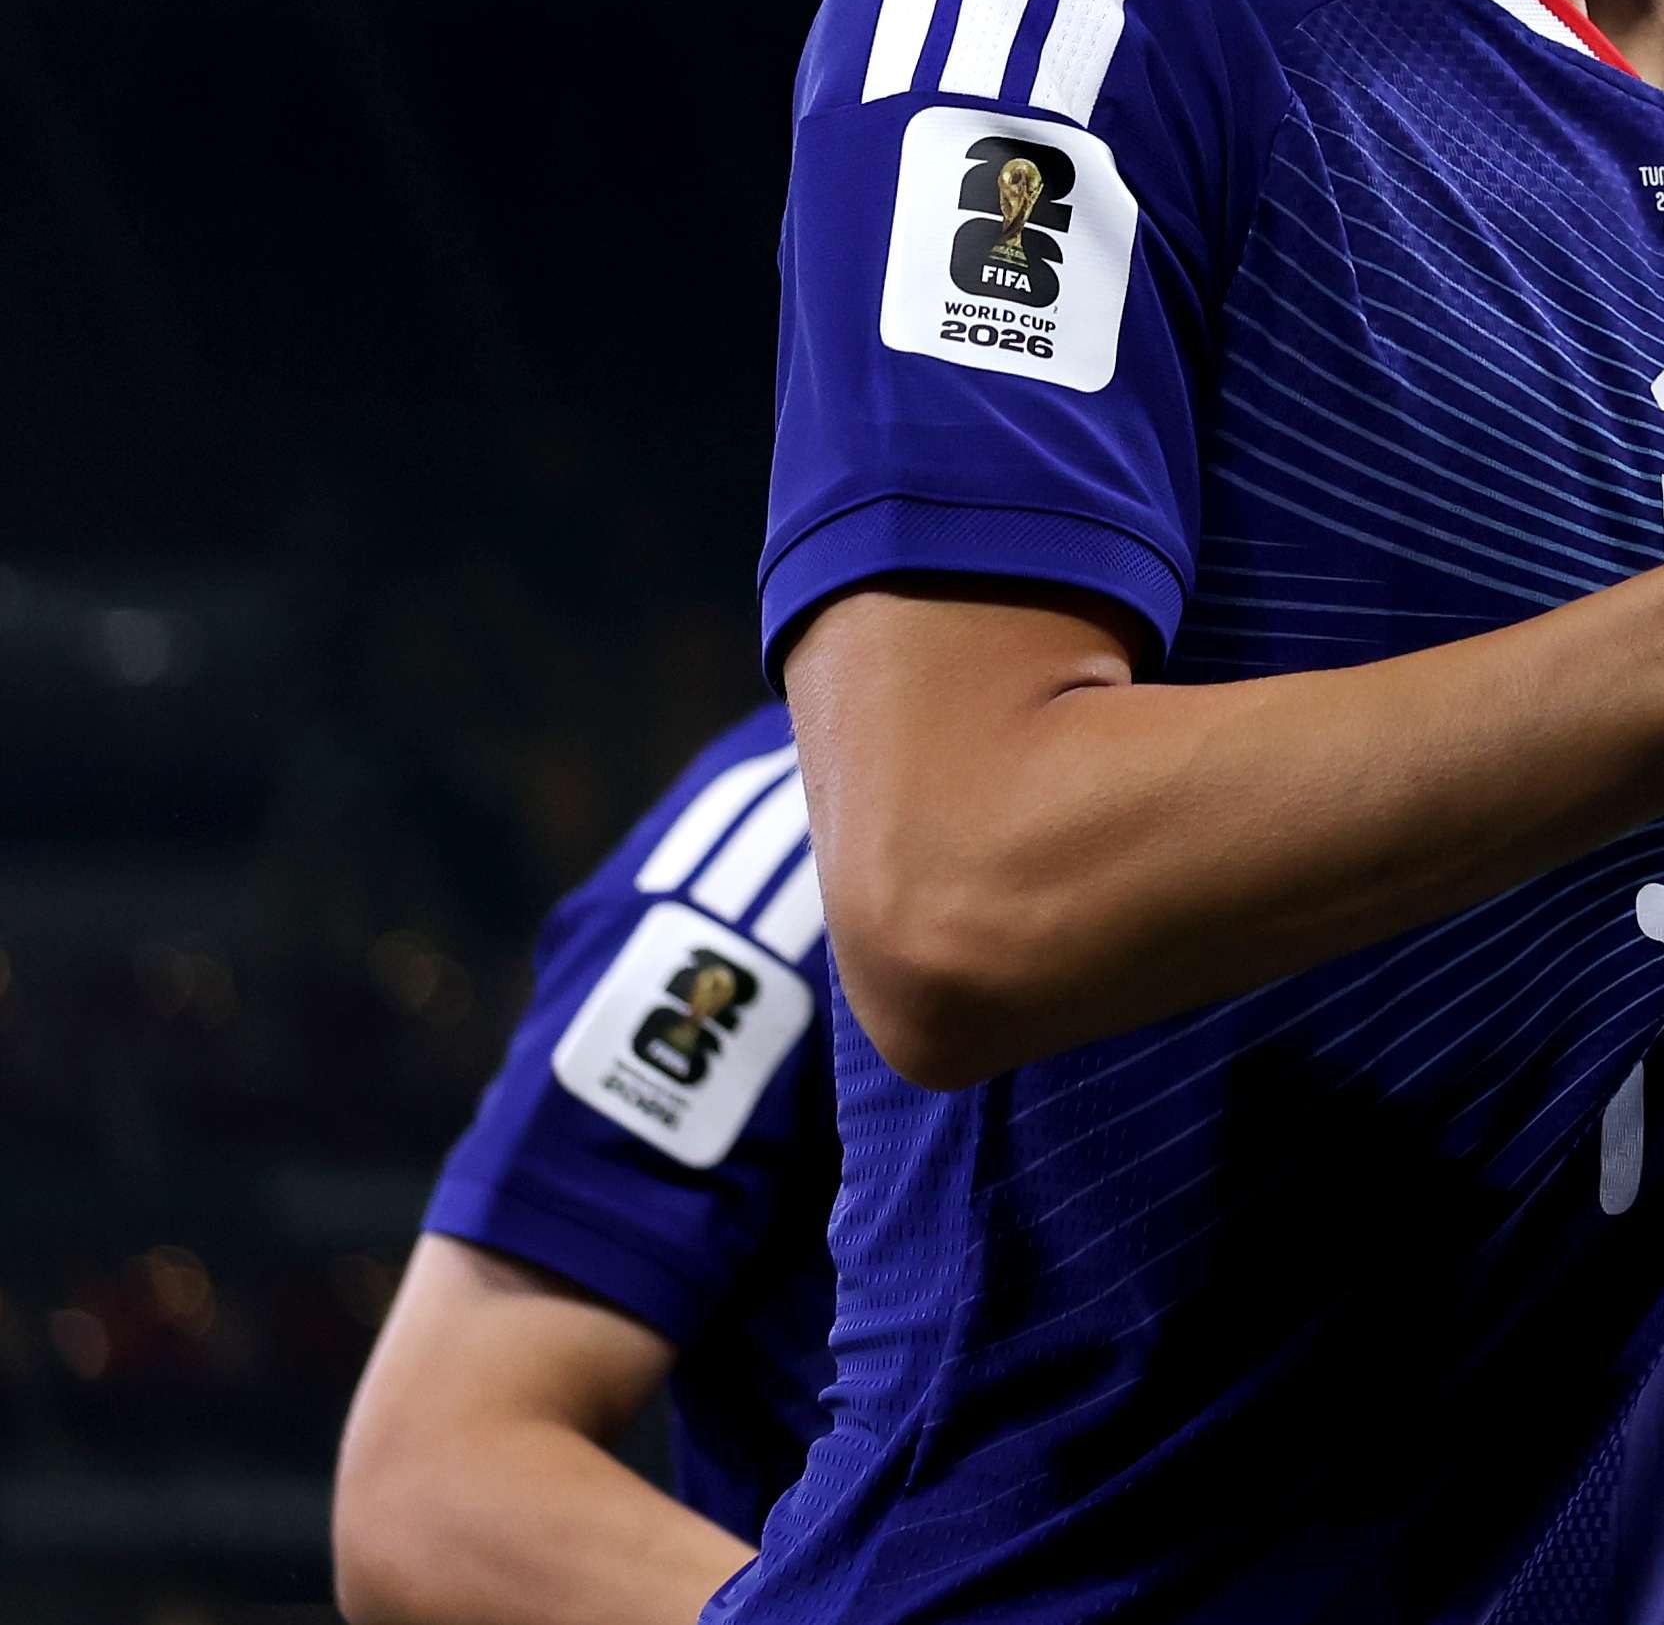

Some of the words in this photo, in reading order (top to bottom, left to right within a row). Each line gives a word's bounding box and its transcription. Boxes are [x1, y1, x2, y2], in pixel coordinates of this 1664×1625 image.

[981, 264, 1032, 293] FIFA
[944, 301, 1015, 324] WORLD
[1019, 314, 1057, 333] CUP
[940, 320, 1054, 359] 2026
